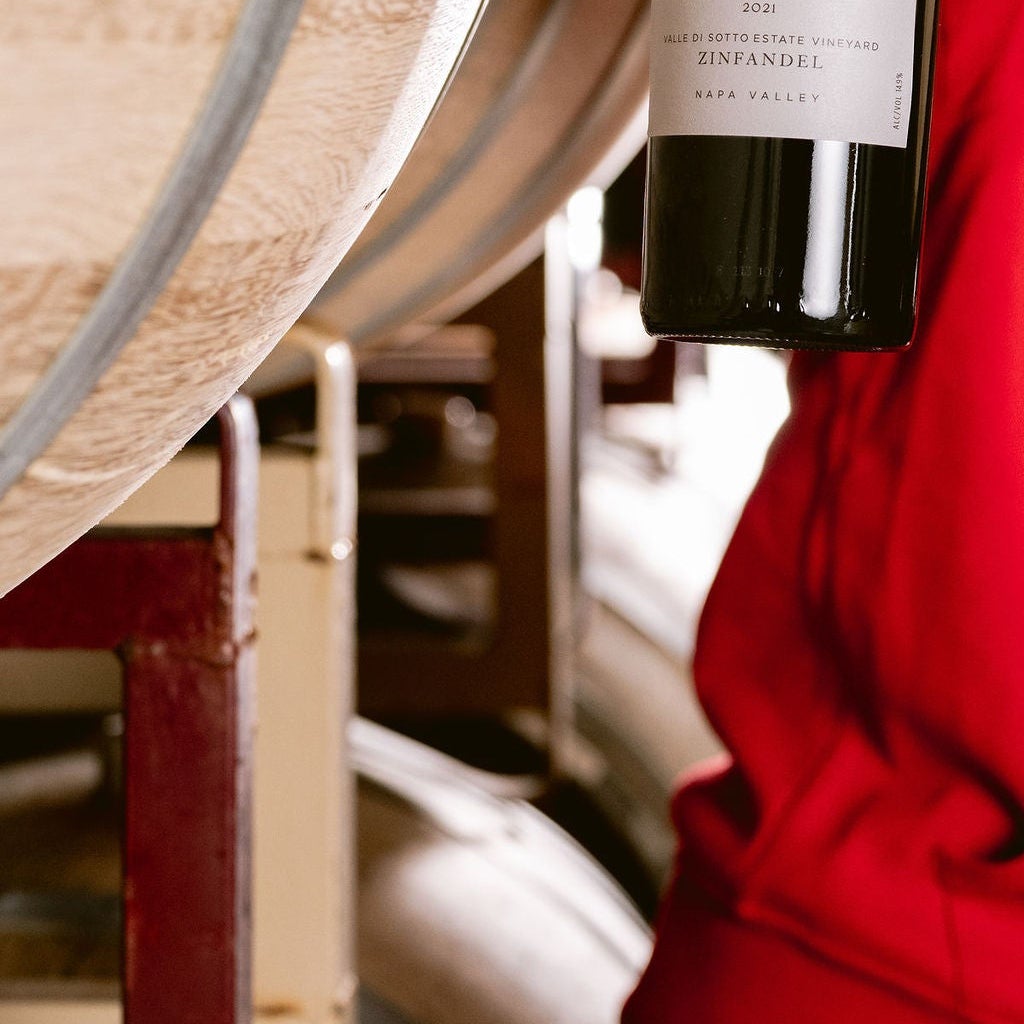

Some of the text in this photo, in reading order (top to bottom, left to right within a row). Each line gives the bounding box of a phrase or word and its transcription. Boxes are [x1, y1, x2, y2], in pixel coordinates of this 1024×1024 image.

[742, 2, 776, 14] 2021
[663, 33, 879, 52] VALLE DI SOTTO ESTATE VINEYARD
[698, 51, 824, 69] ZINFANDEL
[695, 90, 820, 103] NAPA VALLEY
[892, 96, 902, 130] ALC/VOL
